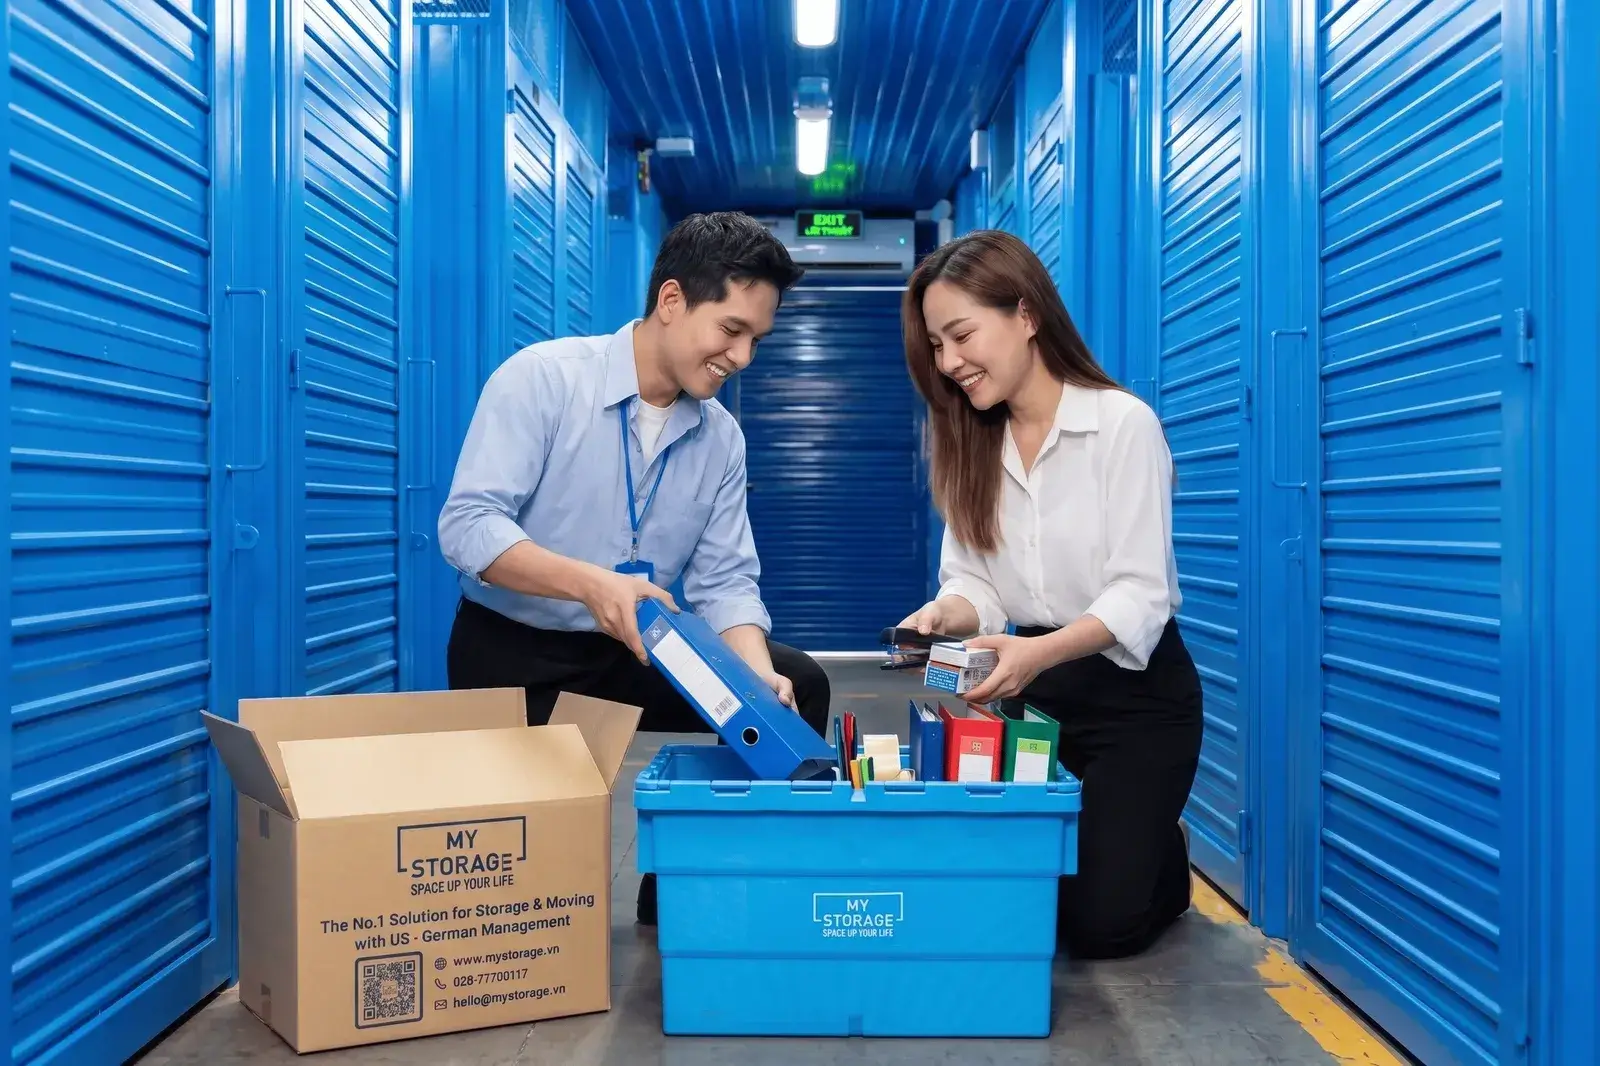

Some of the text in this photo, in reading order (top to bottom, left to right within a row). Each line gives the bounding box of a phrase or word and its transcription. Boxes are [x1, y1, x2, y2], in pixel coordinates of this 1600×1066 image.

[814, 214, 846, 226] EXIT
[446, 829, 478, 850] MY
[411, 852, 512, 878] STORAGE
[410, 874, 514, 896] SPACE UP YOUR LIFE
[320, 894, 594, 934] The No.1 Solution for Storage & Moving
[846, 899, 869, 912] MY
[823, 914, 894, 926] STORAGE
[355, 934, 386, 950] with
[390, 932, 410, 946] US
[422, 926, 477, 942] German
[482, 914, 570, 936] Management
[822, 928, 894, 938] SPACE UP YOUR LIFE
[454, 946, 560, 966] www.mystorage.vn
[454, 968, 528, 987] 028-77700117
[454, 985, 566, 1008] hello@mystorage.vn
